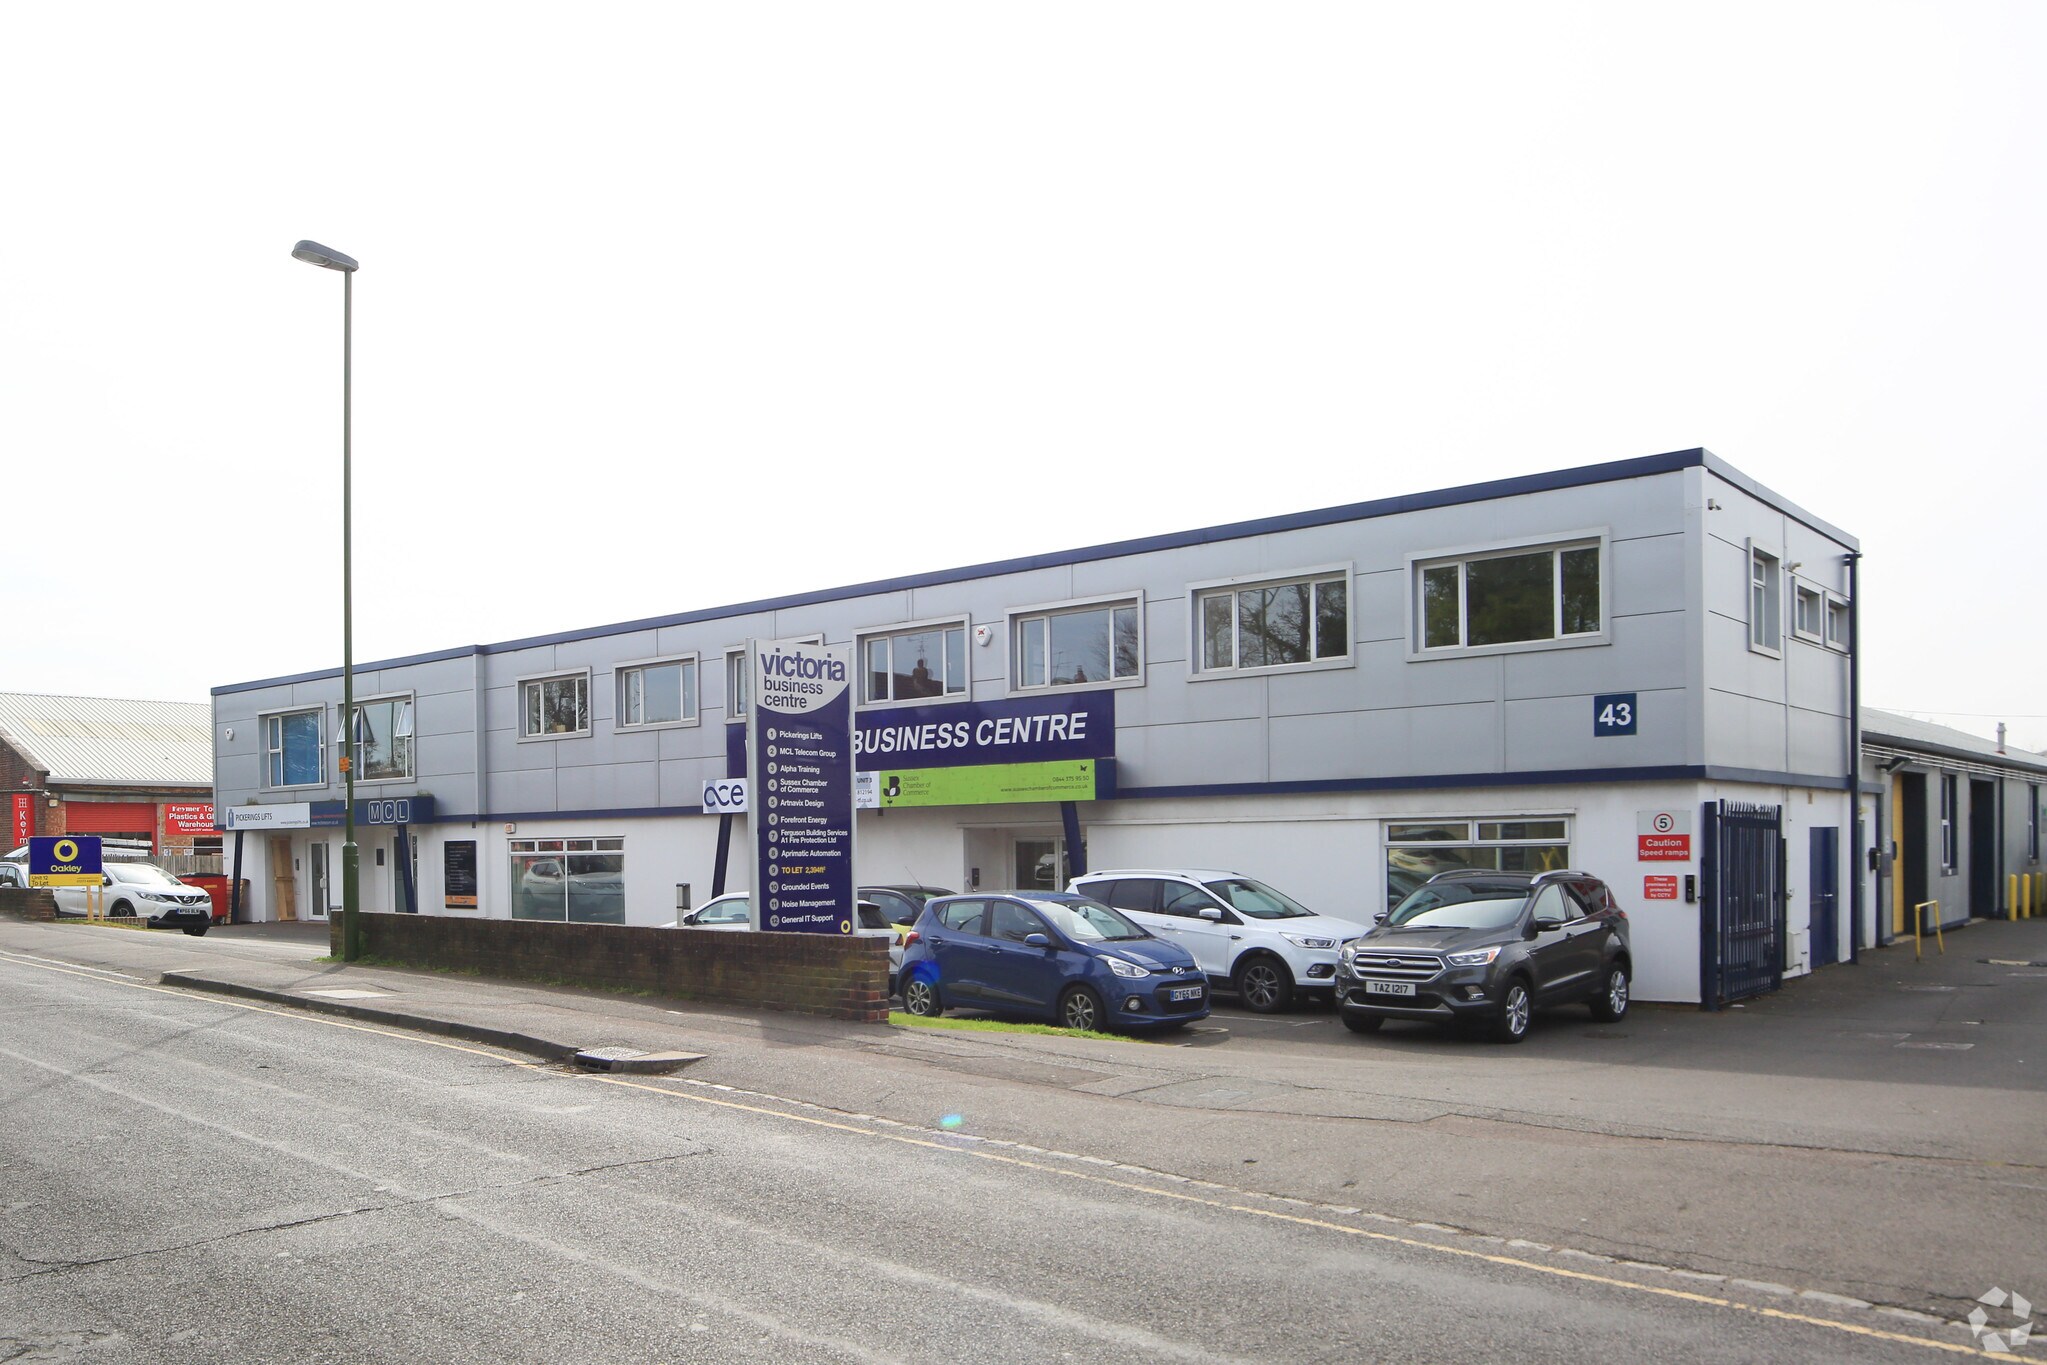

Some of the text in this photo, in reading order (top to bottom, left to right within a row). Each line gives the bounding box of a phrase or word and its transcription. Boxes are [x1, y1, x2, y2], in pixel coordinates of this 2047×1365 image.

[760, 648, 845, 681] victoria
[764, 676, 823, 694] business
[764, 694, 807, 708] centre
[1599, 703, 1632, 726] 43
[780, 730, 809, 740] Pickerings
[855, 712, 1088, 754] BUSINESS CENTRE
[794, 748, 818, 756] Telecom
[819, 750, 836, 758] Group
[780, 765, 797, 773] Alpha
[798, 766, 820, 774] Training
[704, 784, 744, 807] ace
[805, 800, 824, 808] Design
[371, 804, 405, 820] MCL
[20, 811, 28, 844] Keym
[1659, 818, 1668, 828] 5
[50, 864, 82, 873] Oakley
[799, 899, 835, 908] Management
[811, 914, 833, 923] Support
[1374, 983, 1408, 993] TAZ 1217
